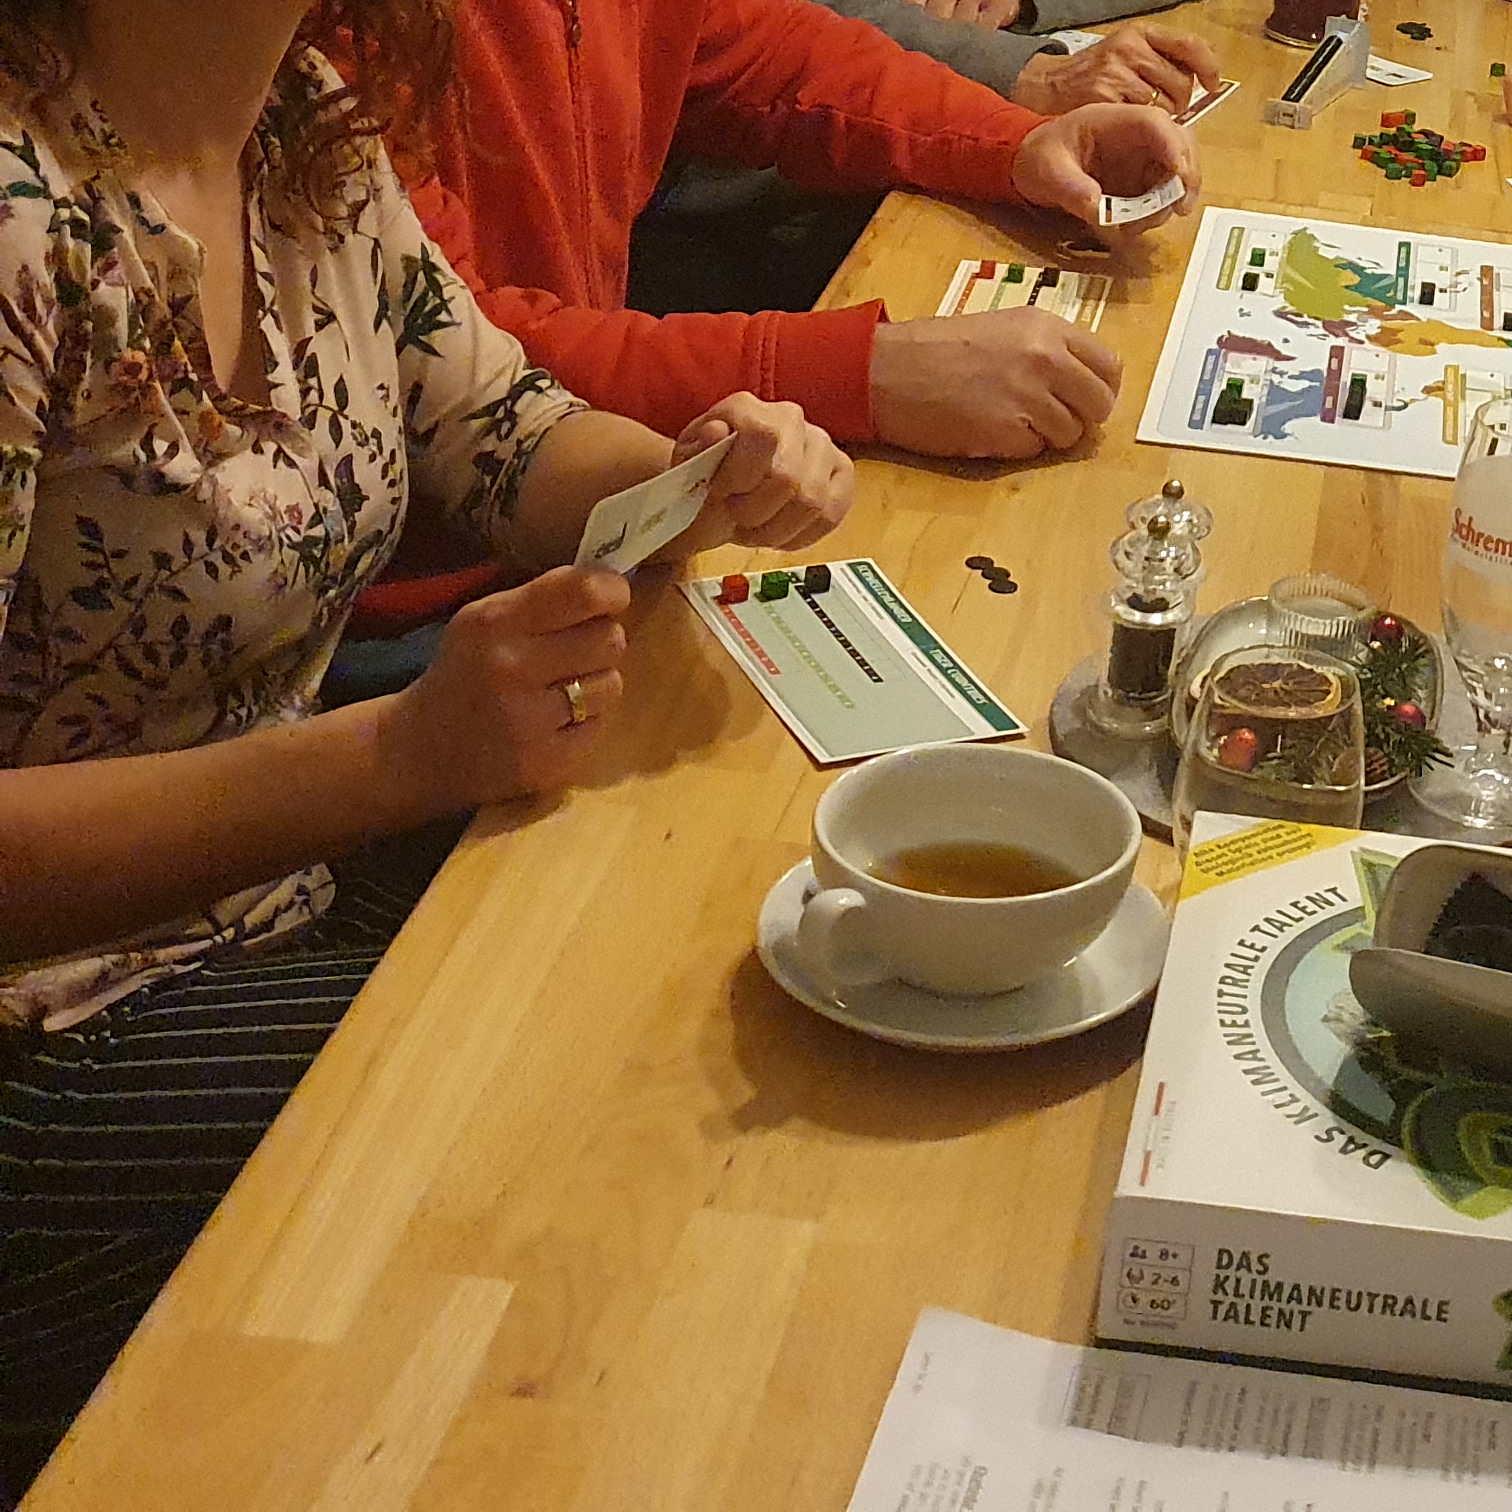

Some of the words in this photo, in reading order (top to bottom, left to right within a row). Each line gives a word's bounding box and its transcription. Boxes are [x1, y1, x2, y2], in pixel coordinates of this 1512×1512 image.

[1249, 886, 1349, 939] TALENT
[1216, 937, 1320, 1126] KLIMANEUTRALE
[1313, 1126, 1393, 1170] DAS
[1216, 1248, 1271, 1276] DAS
[1209, 1299, 1313, 1333] TALENT
[1211, 1273, 1451, 1324] KLIMANEUTRALE
